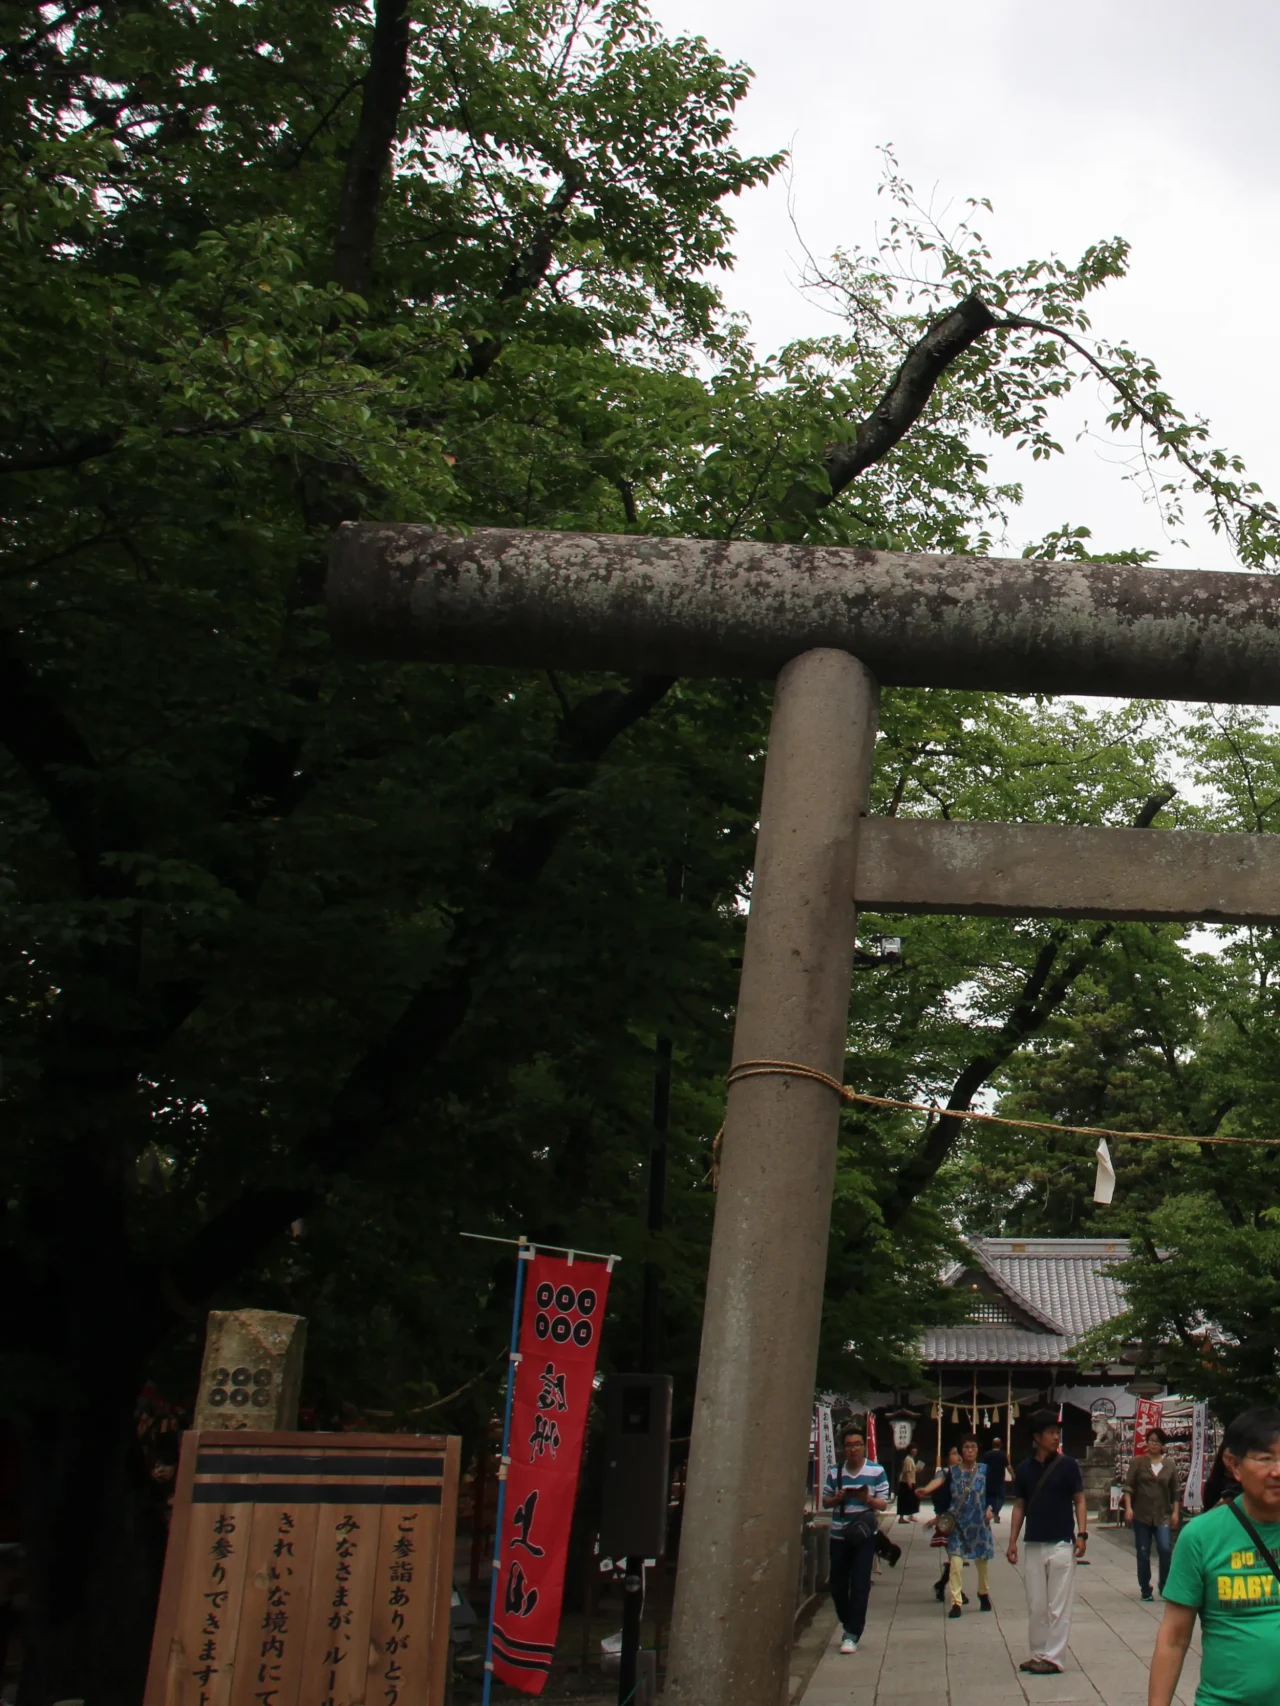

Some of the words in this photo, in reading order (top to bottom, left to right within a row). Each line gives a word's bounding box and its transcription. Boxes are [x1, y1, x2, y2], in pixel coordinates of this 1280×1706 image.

[254, 1512, 295, 1706] きれいな境内にて
[383, 1513, 419, 1706] ご参詣ありがとう
[1217, 1575, 1274, 1601] BABY
